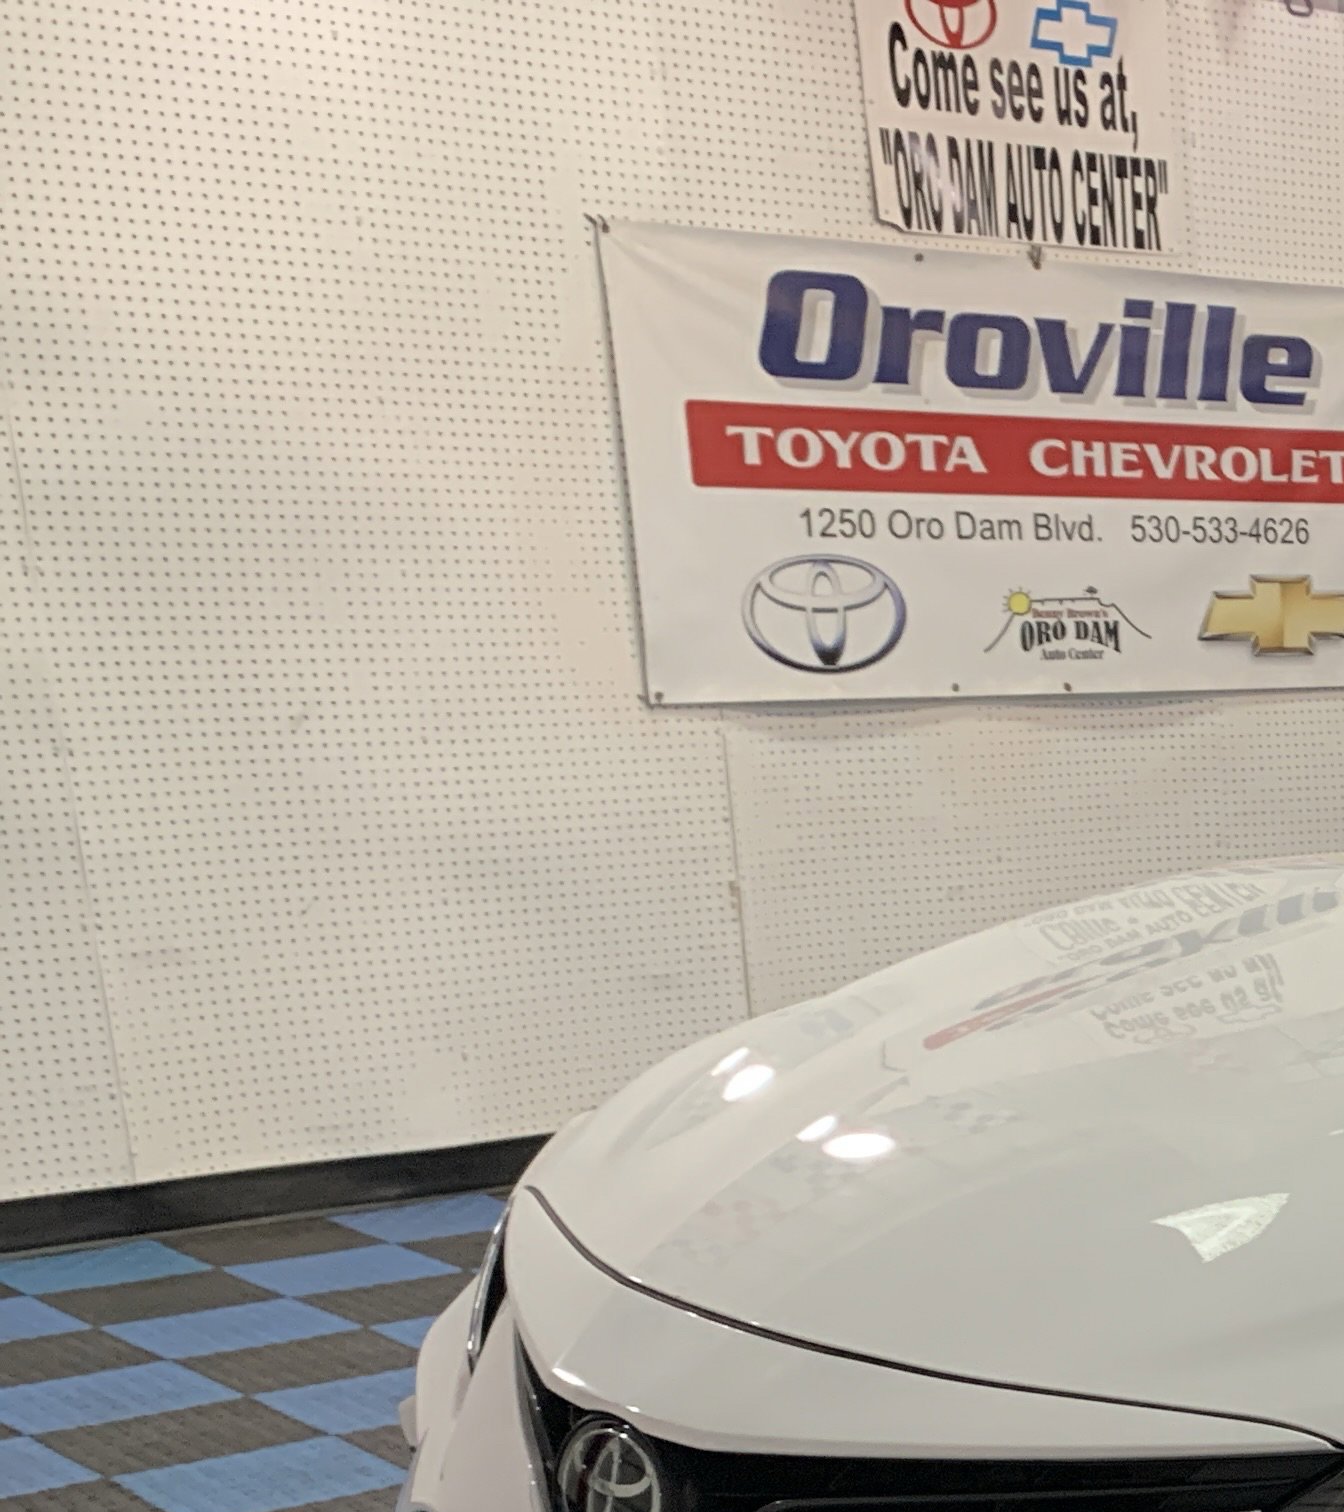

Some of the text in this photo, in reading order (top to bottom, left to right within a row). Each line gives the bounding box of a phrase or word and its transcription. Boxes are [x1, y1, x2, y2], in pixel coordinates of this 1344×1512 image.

[888, 21, 1138, 152] Come see us at,
[947, 135, 1000, 237] DAM
[1006, 142, 1065, 244] AUTO
[1071, 149, 1168, 251] CENTER"
[758, 267, 1314, 407] Oroville
[725, 425, 987, 474] TOYOTA
[800, 507, 1309, 545] 1250 Oro Dam Blvd. 530-533-4626
[1021, 620, 1121, 653] ORO DAM
[1041, 649, 1104, 660] Auto Center
